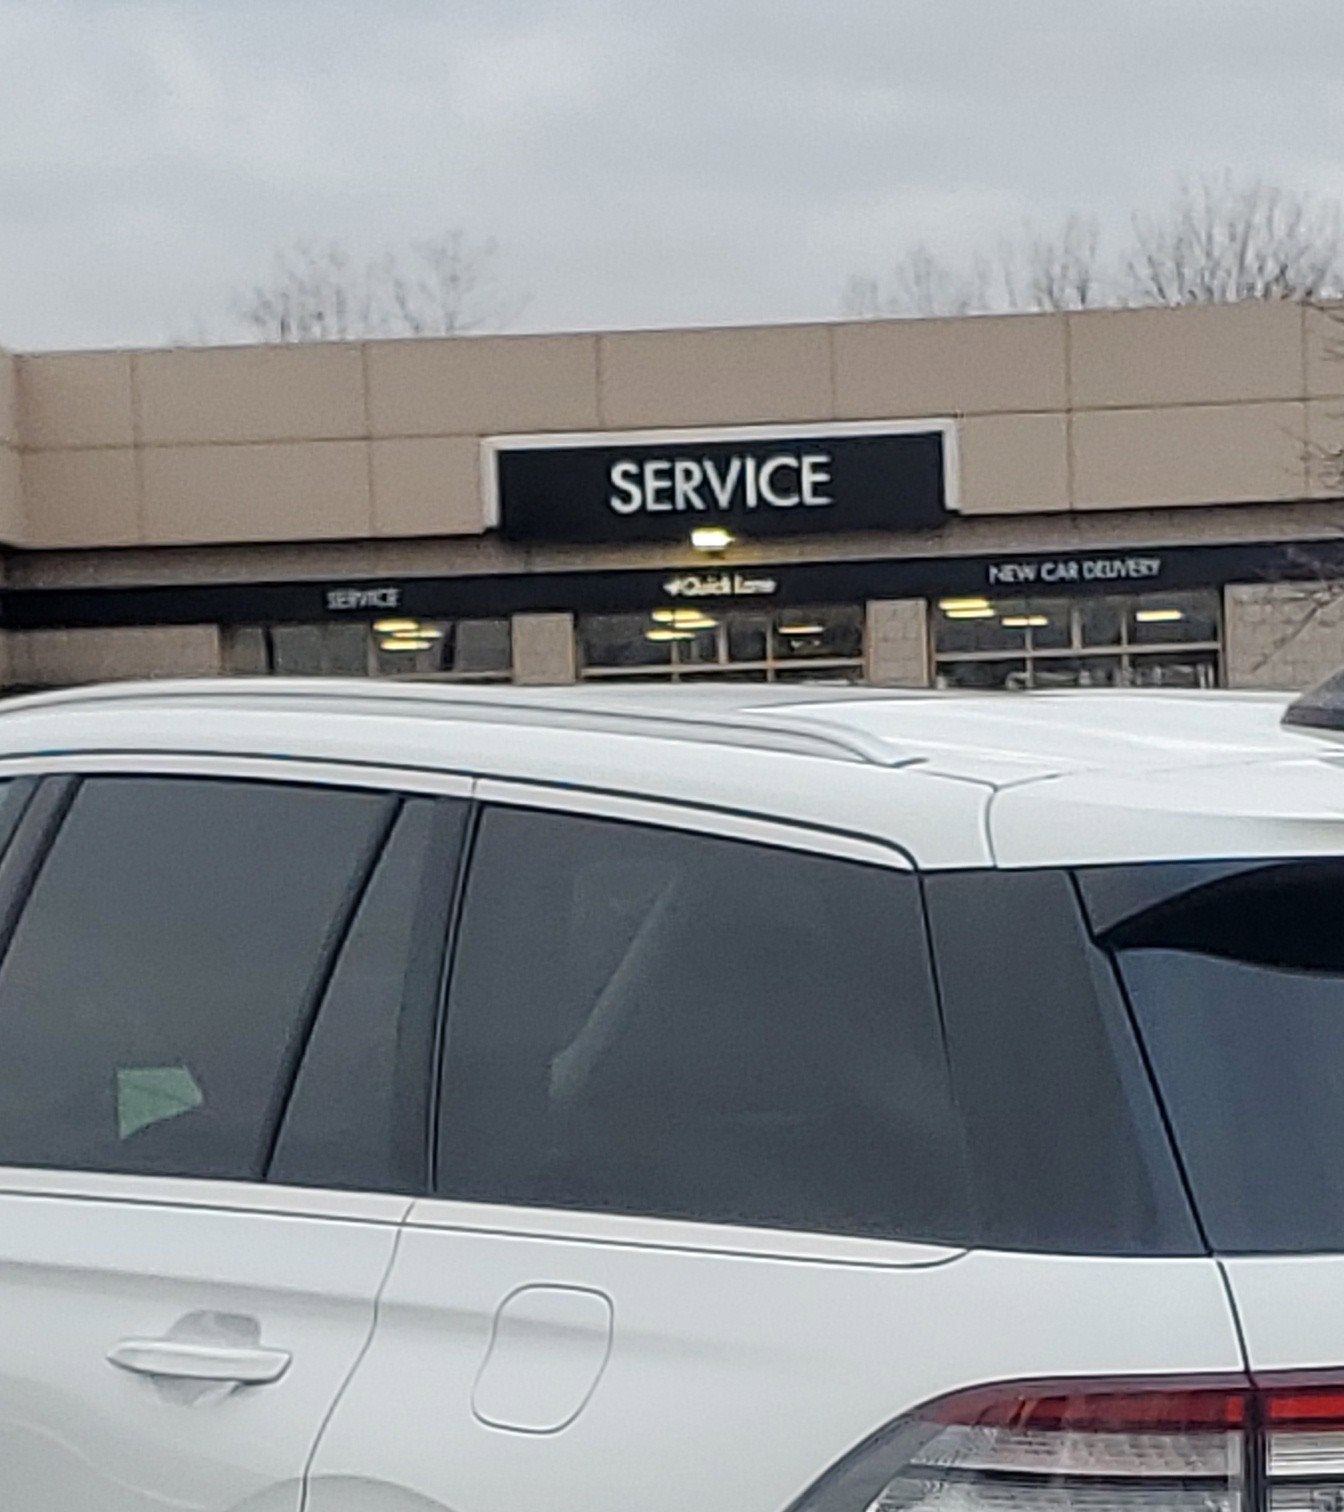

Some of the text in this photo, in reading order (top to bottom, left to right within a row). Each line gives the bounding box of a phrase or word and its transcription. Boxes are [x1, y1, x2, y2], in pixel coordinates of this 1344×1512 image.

[609, 455, 834, 514] SERVICE
[988, 557, 1161, 585] NEW CAR DELIVERY
